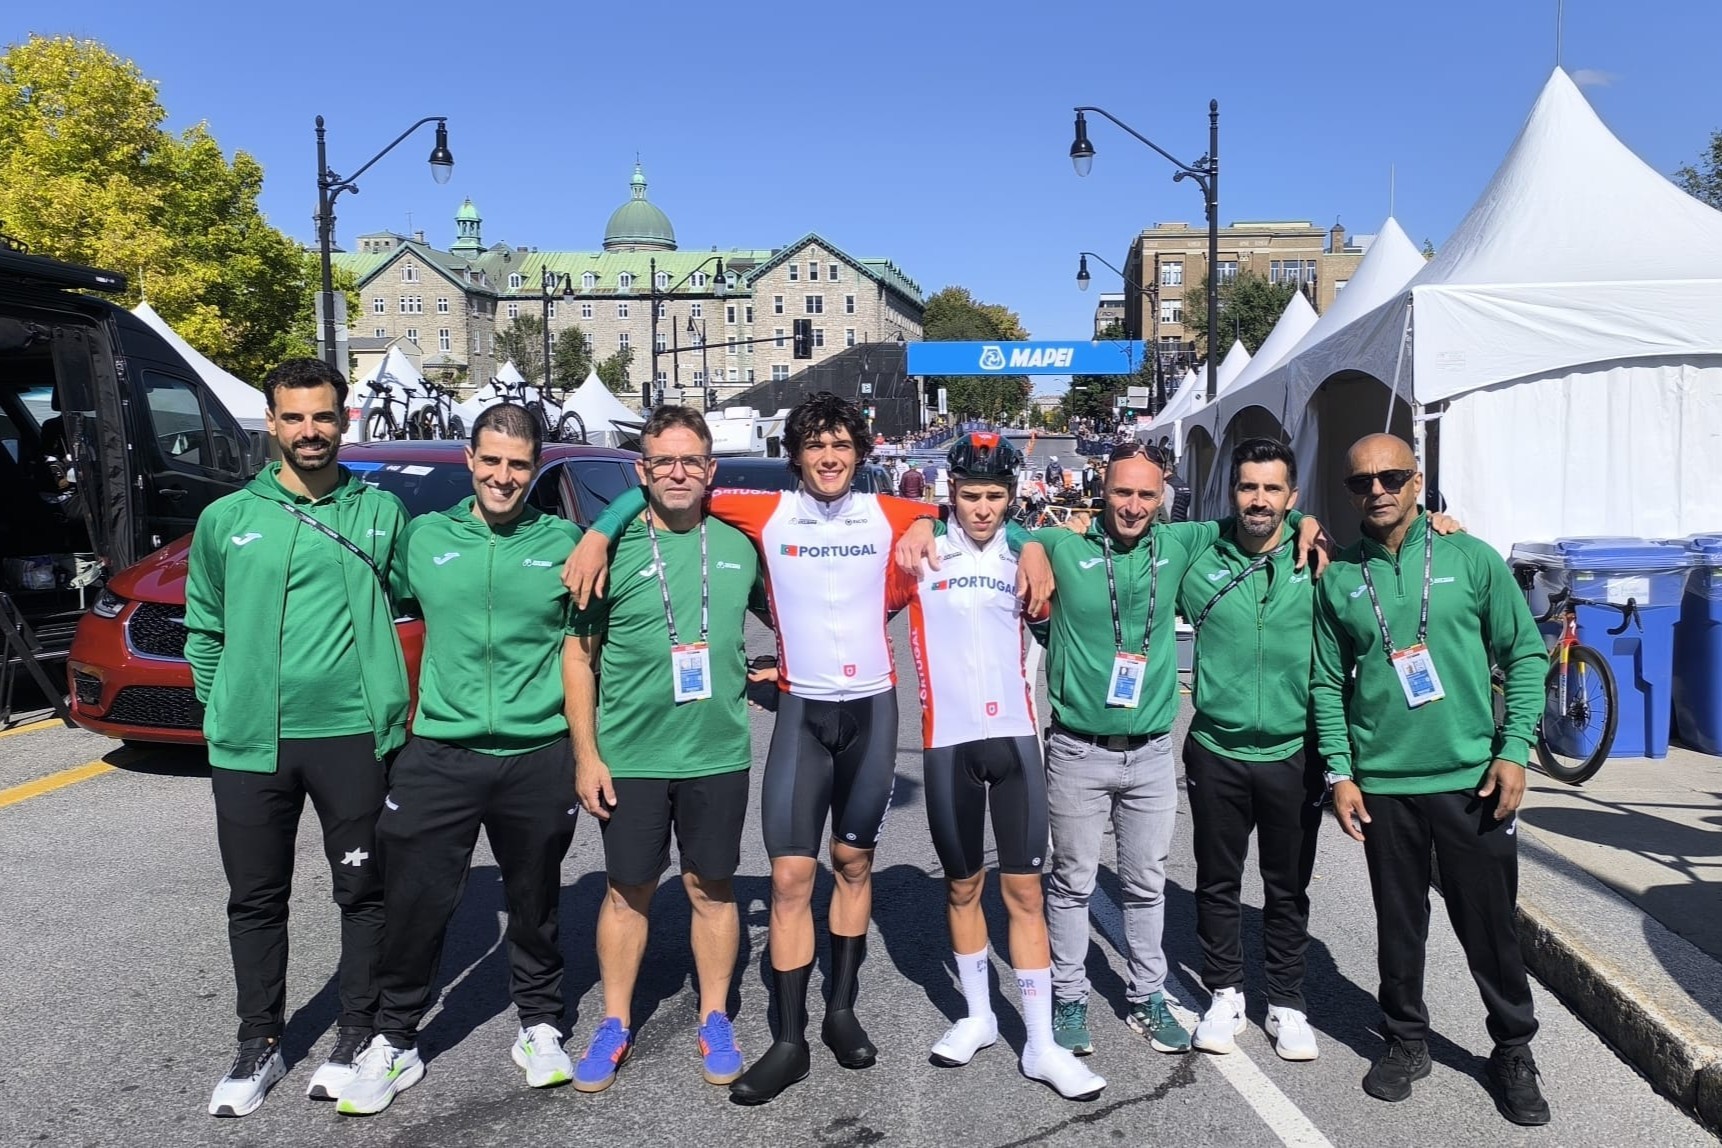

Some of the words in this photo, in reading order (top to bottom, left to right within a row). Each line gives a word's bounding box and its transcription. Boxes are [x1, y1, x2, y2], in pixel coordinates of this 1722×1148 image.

[1009, 348, 1074, 367] MAPEI
[799, 544, 877, 557] PORTUGAL
[948, 576, 1017, 596] PORTUGAL
